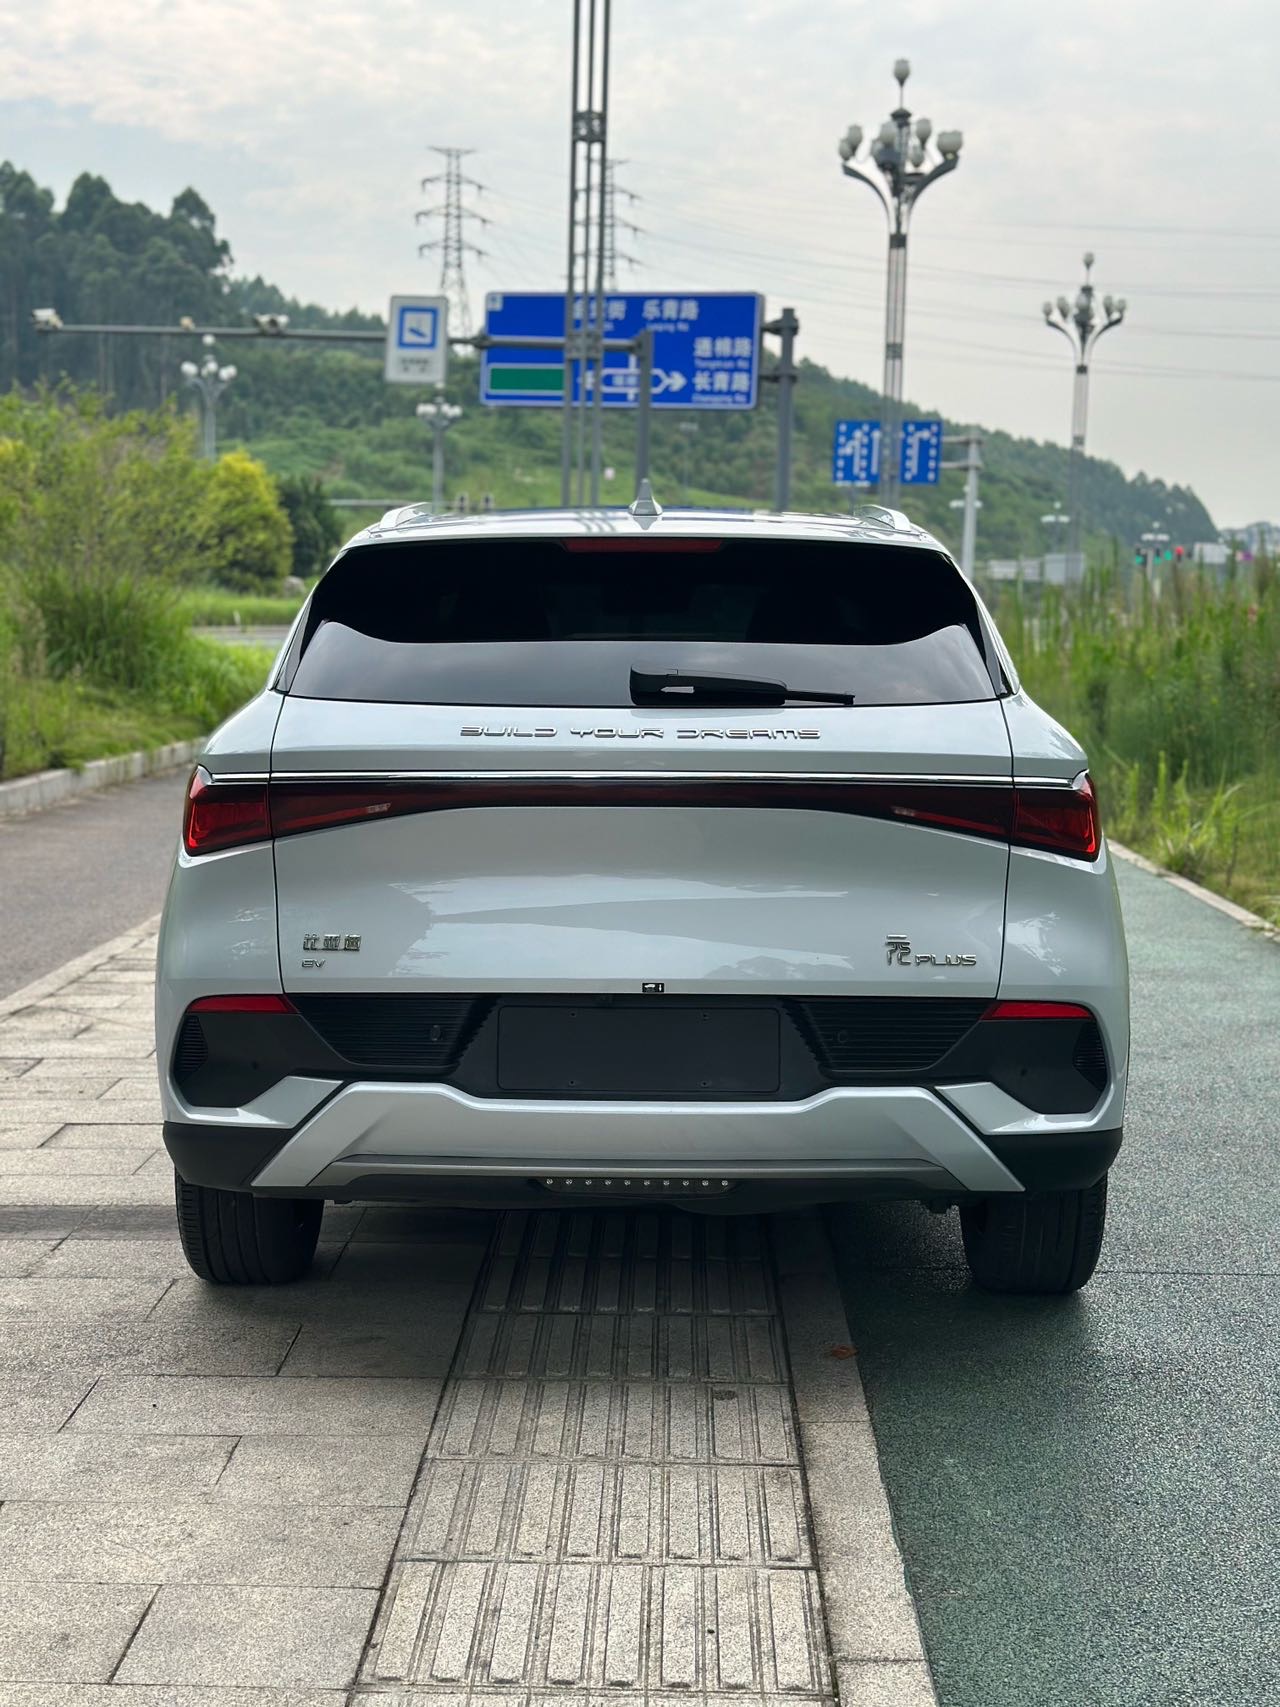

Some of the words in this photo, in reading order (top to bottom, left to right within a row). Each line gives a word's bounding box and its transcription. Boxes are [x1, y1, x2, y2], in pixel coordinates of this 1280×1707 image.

[460, 725, 557, 738] BUILD
[570, 727, 664, 739] YOUR
[677, 728, 821, 740] DREAMS
[302, 958, 325, 968] EV
[915, 954, 977, 966] PLUS
